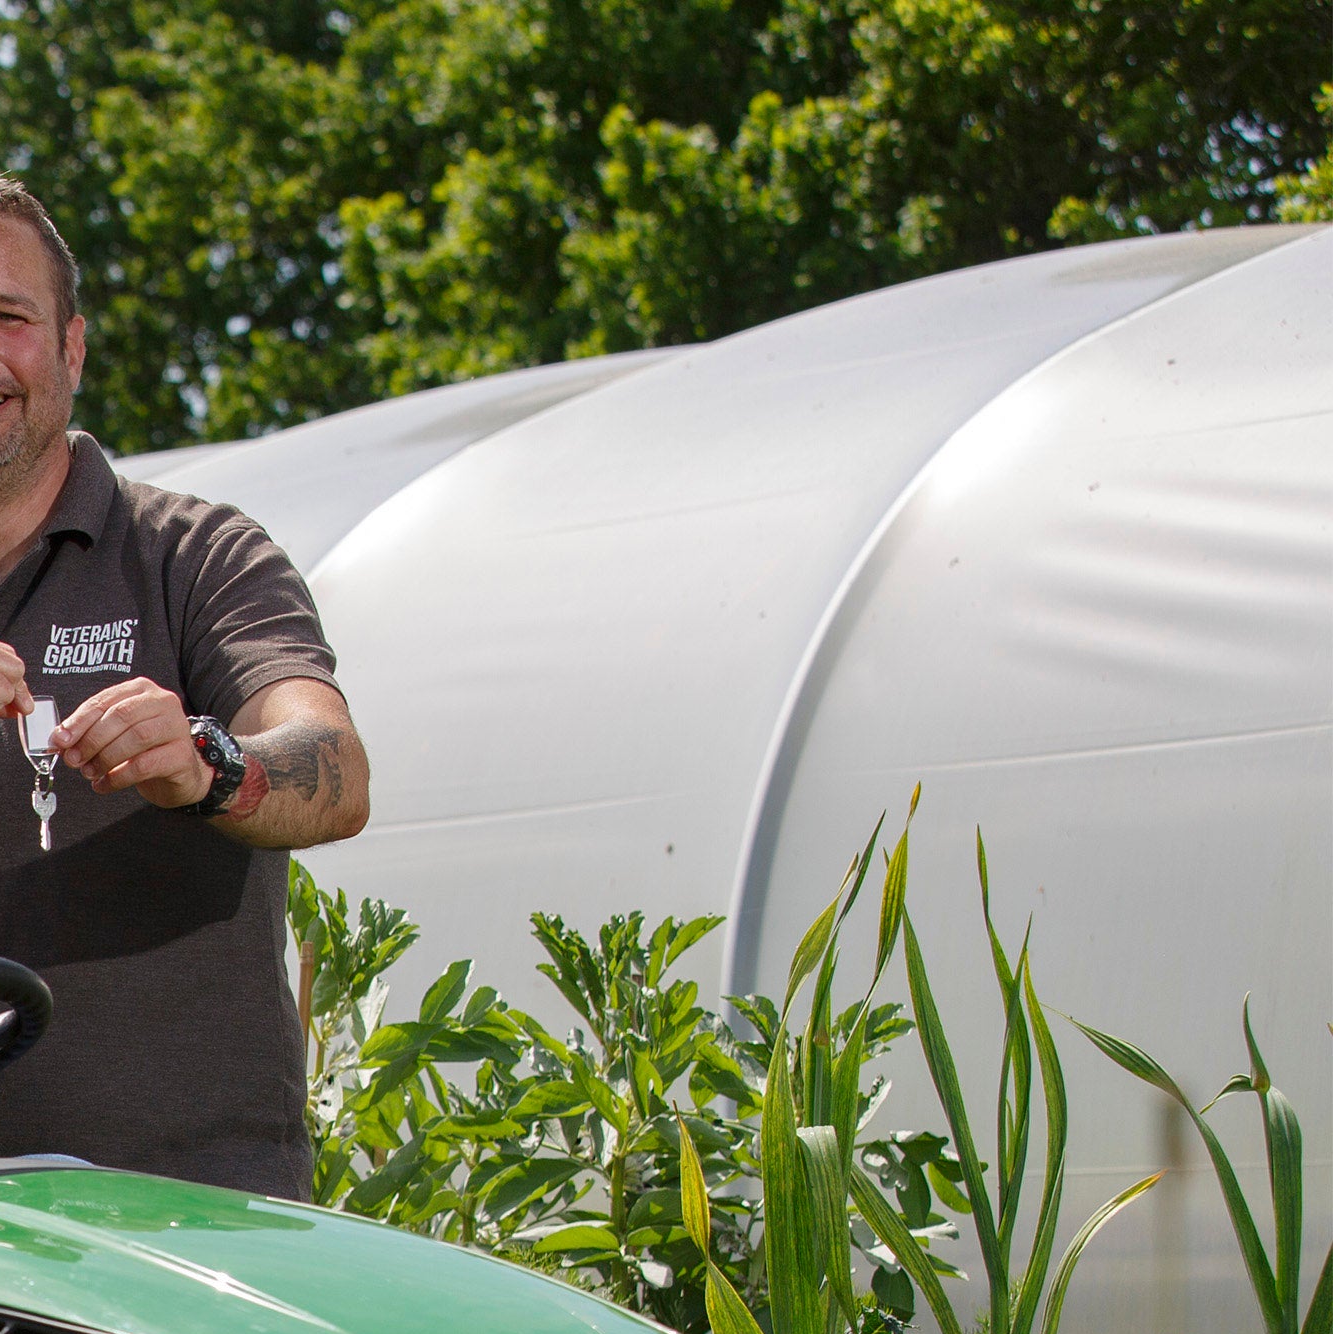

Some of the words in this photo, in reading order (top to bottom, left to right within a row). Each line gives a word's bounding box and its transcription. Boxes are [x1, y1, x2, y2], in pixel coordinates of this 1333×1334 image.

[50, 619, 139, 645] VETERANS'
[43, 639, 135, 668] GROWTH
[42, 662, 132, 675] WWW.VETERANSGROWTH.ORG
